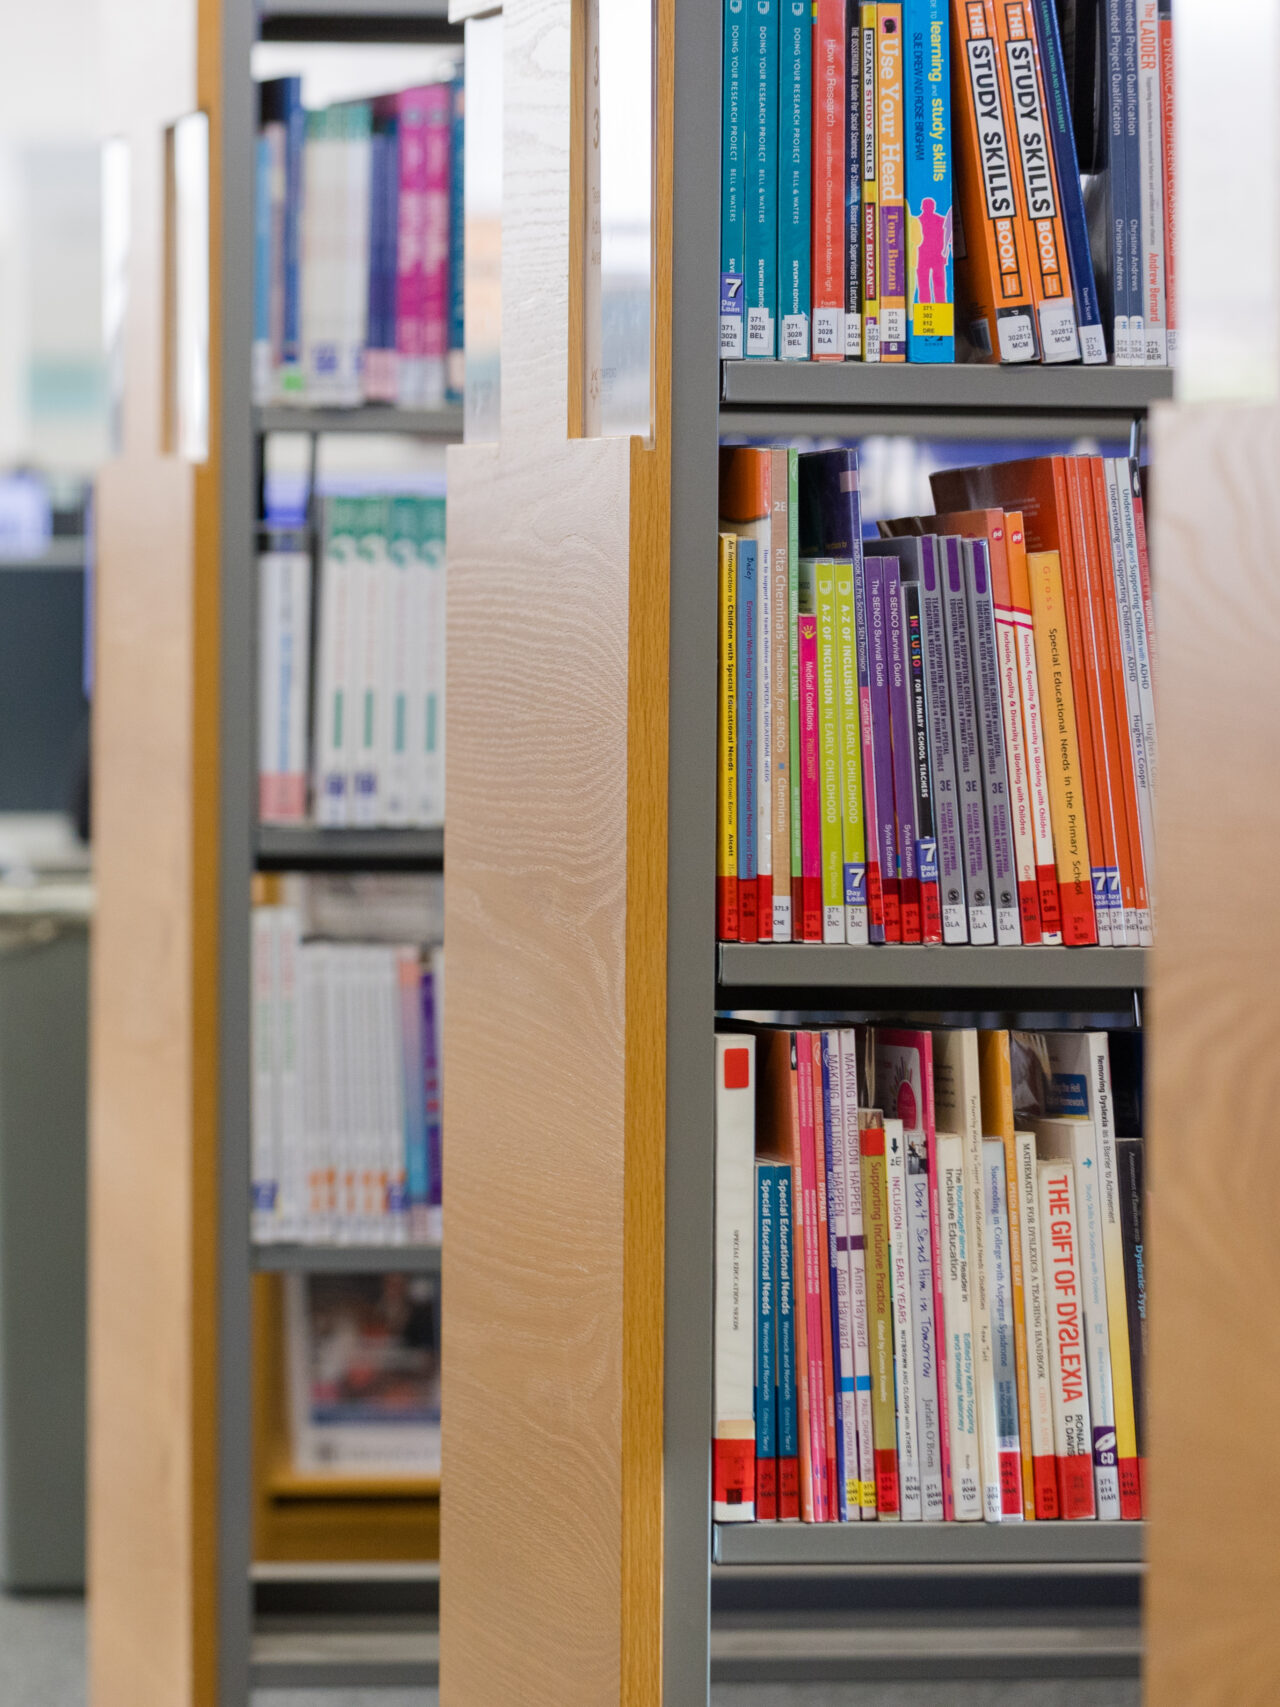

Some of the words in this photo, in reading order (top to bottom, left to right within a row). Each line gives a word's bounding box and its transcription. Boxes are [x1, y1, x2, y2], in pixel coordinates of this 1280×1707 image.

[970, 6, 984, 36] THE
[1008, 7, 1024, 37] THE
[1144, 4, 1156, 18] The
[731, 25, 739, 53] DOING
[826, 40, 836, 62] How
[913, 32, 922, 48] SUE
[928, 21, 944, 82] learning
[1109, 36, 1121, 71] Project
[1124, 36, 1136, 72] Project
[1140, 20, 1156, 70] LADDER
[826, 64, 835, 76] to
[880, 38, 898, 79] Use
[914, 50, 923, 78] DREW
[914, 78, 923, 95] AND
[972, 46, 998, 120] STUDY
[1012, 46, 1038, 121] STUDY
[1048, 38, 1056, 72] TEACHING
[1054, 90, 1066, 133] ASSESSMENT
[730, 81, 738, 122] RESEARCH
[758, 82, 766, 124] RESEARCH
[826, 78, 836, 127] Research
[880, 82, 900, 137] Your
[914, 96, 924, 120] ROSIE
[930, 98, 946, 140] study
[1112, 74, 1122, 136] Qualification
[1127, 74, 1136, 136] Qualification
[730, 126, 738, 161] PROJECT
[758, 127, 766, 162] PROJECT
[792, 128, 800, 164] PROJECT
[914, 122, 924, 160] BINGHAM
[882, 144, 902, 200] Head
[933, 144, 946, 182] skills
[984, 132, 1010, 212] SKILLS
[1024, 132, 1050, 212] SKILLS
[886, 212, 898, 244] Tony
[997, 220, 1016, 270] BOOK
[1037, 221, 1056, 270] BOOK
[1130, 219, 1138, 255] Christine
[888, 249, 898, 290] Buzan
[1116, 256, 1124, 291] Andrews
[1149, 252, 1160, 286] Andrew
[722, 300, 736, 308] Day
[725, 278, 742, 298] 7
[1150, 288, 1160, 322] Bernard
[774, 502, 786, 512] 2E
[775, 548, 786, 572] Rita
[1043, 566, 1052, 610] Gross
[822, 604, 830, 622] A-Z
[840, 604, 850, 623] A-Z
[873, 596, 882, 628] SENCO
[890, 596, 899, 628] SENCO
[822, 626, 831, 641] OF
[842, 627, 851, 642] OF
[874, 630, 882, 660] Survival
[892, 630, 900, 660] Survival
[1049, 628, 1061, 666] Special
[776, 645, 785, 693] Handbook
[806, 661, 814, 690] Medical
[823, 644, 832, 704] INCLUSION
[842, 645, 853, 705] INCLUSION
[876, 663, 884, 686] Guide
[894, 663, 902, 687] Guide
[776, 696, 785, 712] for
[806, 692, 814, 731] Conditions
[824, 708, 833, 719] IN
[845, 708, 854, 720] IN
[910, 616, 922, 675] INCLUSION
[916, 695, 924, 728] PRIMARY
[920, 763, 929, 798] TEACHERS
[1054, 672, 1067, 733] Educational
[824, 722, 834, 757] EARLY
[845, 724, 854, 757] EARLY
[1061, 738, 1070, 771] Needs
[826, 759, 837, 824] CHILDHOOD
[846, 760, 858, 824] CHILDHOOD
[1064, 776, 1071, 786] in
[777, 777, 787, 832] Cheminais
[1066, 791, 1075, 809] the
[1069, 814, 1078, 855] Primary
[905, 848, 913, 877] Edwards
[1072, 860, 1083, 895] School
[829, 1054, 839, 1100] MAKING
[844, 1053, 855, 1098] MAKING
[831, 1103, 842, 1166] INCLUSION
[846, 1104, 858, 1165] INCLUSION
[761, 1180, 771, 1216] Special
[778, 1179, 788, 1216] Special
[834, 1171, 845, 1216] HAPPEN
[850, 1169, 861, 1216] HAPPEN
[870, 1162, 881, 1220] Supporting
[892, 1177, 902, 1230] INCLUSION
[946, 1169, 954, 1219] Inclusive
[1048, 1175, 1070, 1216] THE
[762, 1219, 771, 1280] Educational
[780, 1218, 789, 1279] Educational
[874, 1224, 885, 1269] Inclusive
[917, 1228, 928, 1263] Send
[948, 1222, 958, 1280] Education
[1051, 1221, 1074, 1266] GIFT
[838, 1268, 847, 1296] Anne
[855, 1267, 864, 1295] Anne
[896, 1258, 904, 1290] EARLY
[919, 1269, 930, 1292] Him
[1054, 1270, 1076, 1296] OF
[762, 1282, 771, 1315] Needs
[781, 1282, 790, 1315] Needs
[876, 1272, 886, 1315] Practice
[897, 1291, 906, 1325] YEARS
[920, 1297, 927, 1312] in
[839, 1300, 849, 1349] Hayward
[856, 1300, 866, 1348] Hayward
[921, 1317, 931, 1378] Tomorrow
[922, 1398, 935, 1426] Jarlath
[1065, 1428, 1076, 1458] DAVIS
[1075, 1414, 1085, 1456] RONALD
[1101, 1453, 1114, 1464] CD
